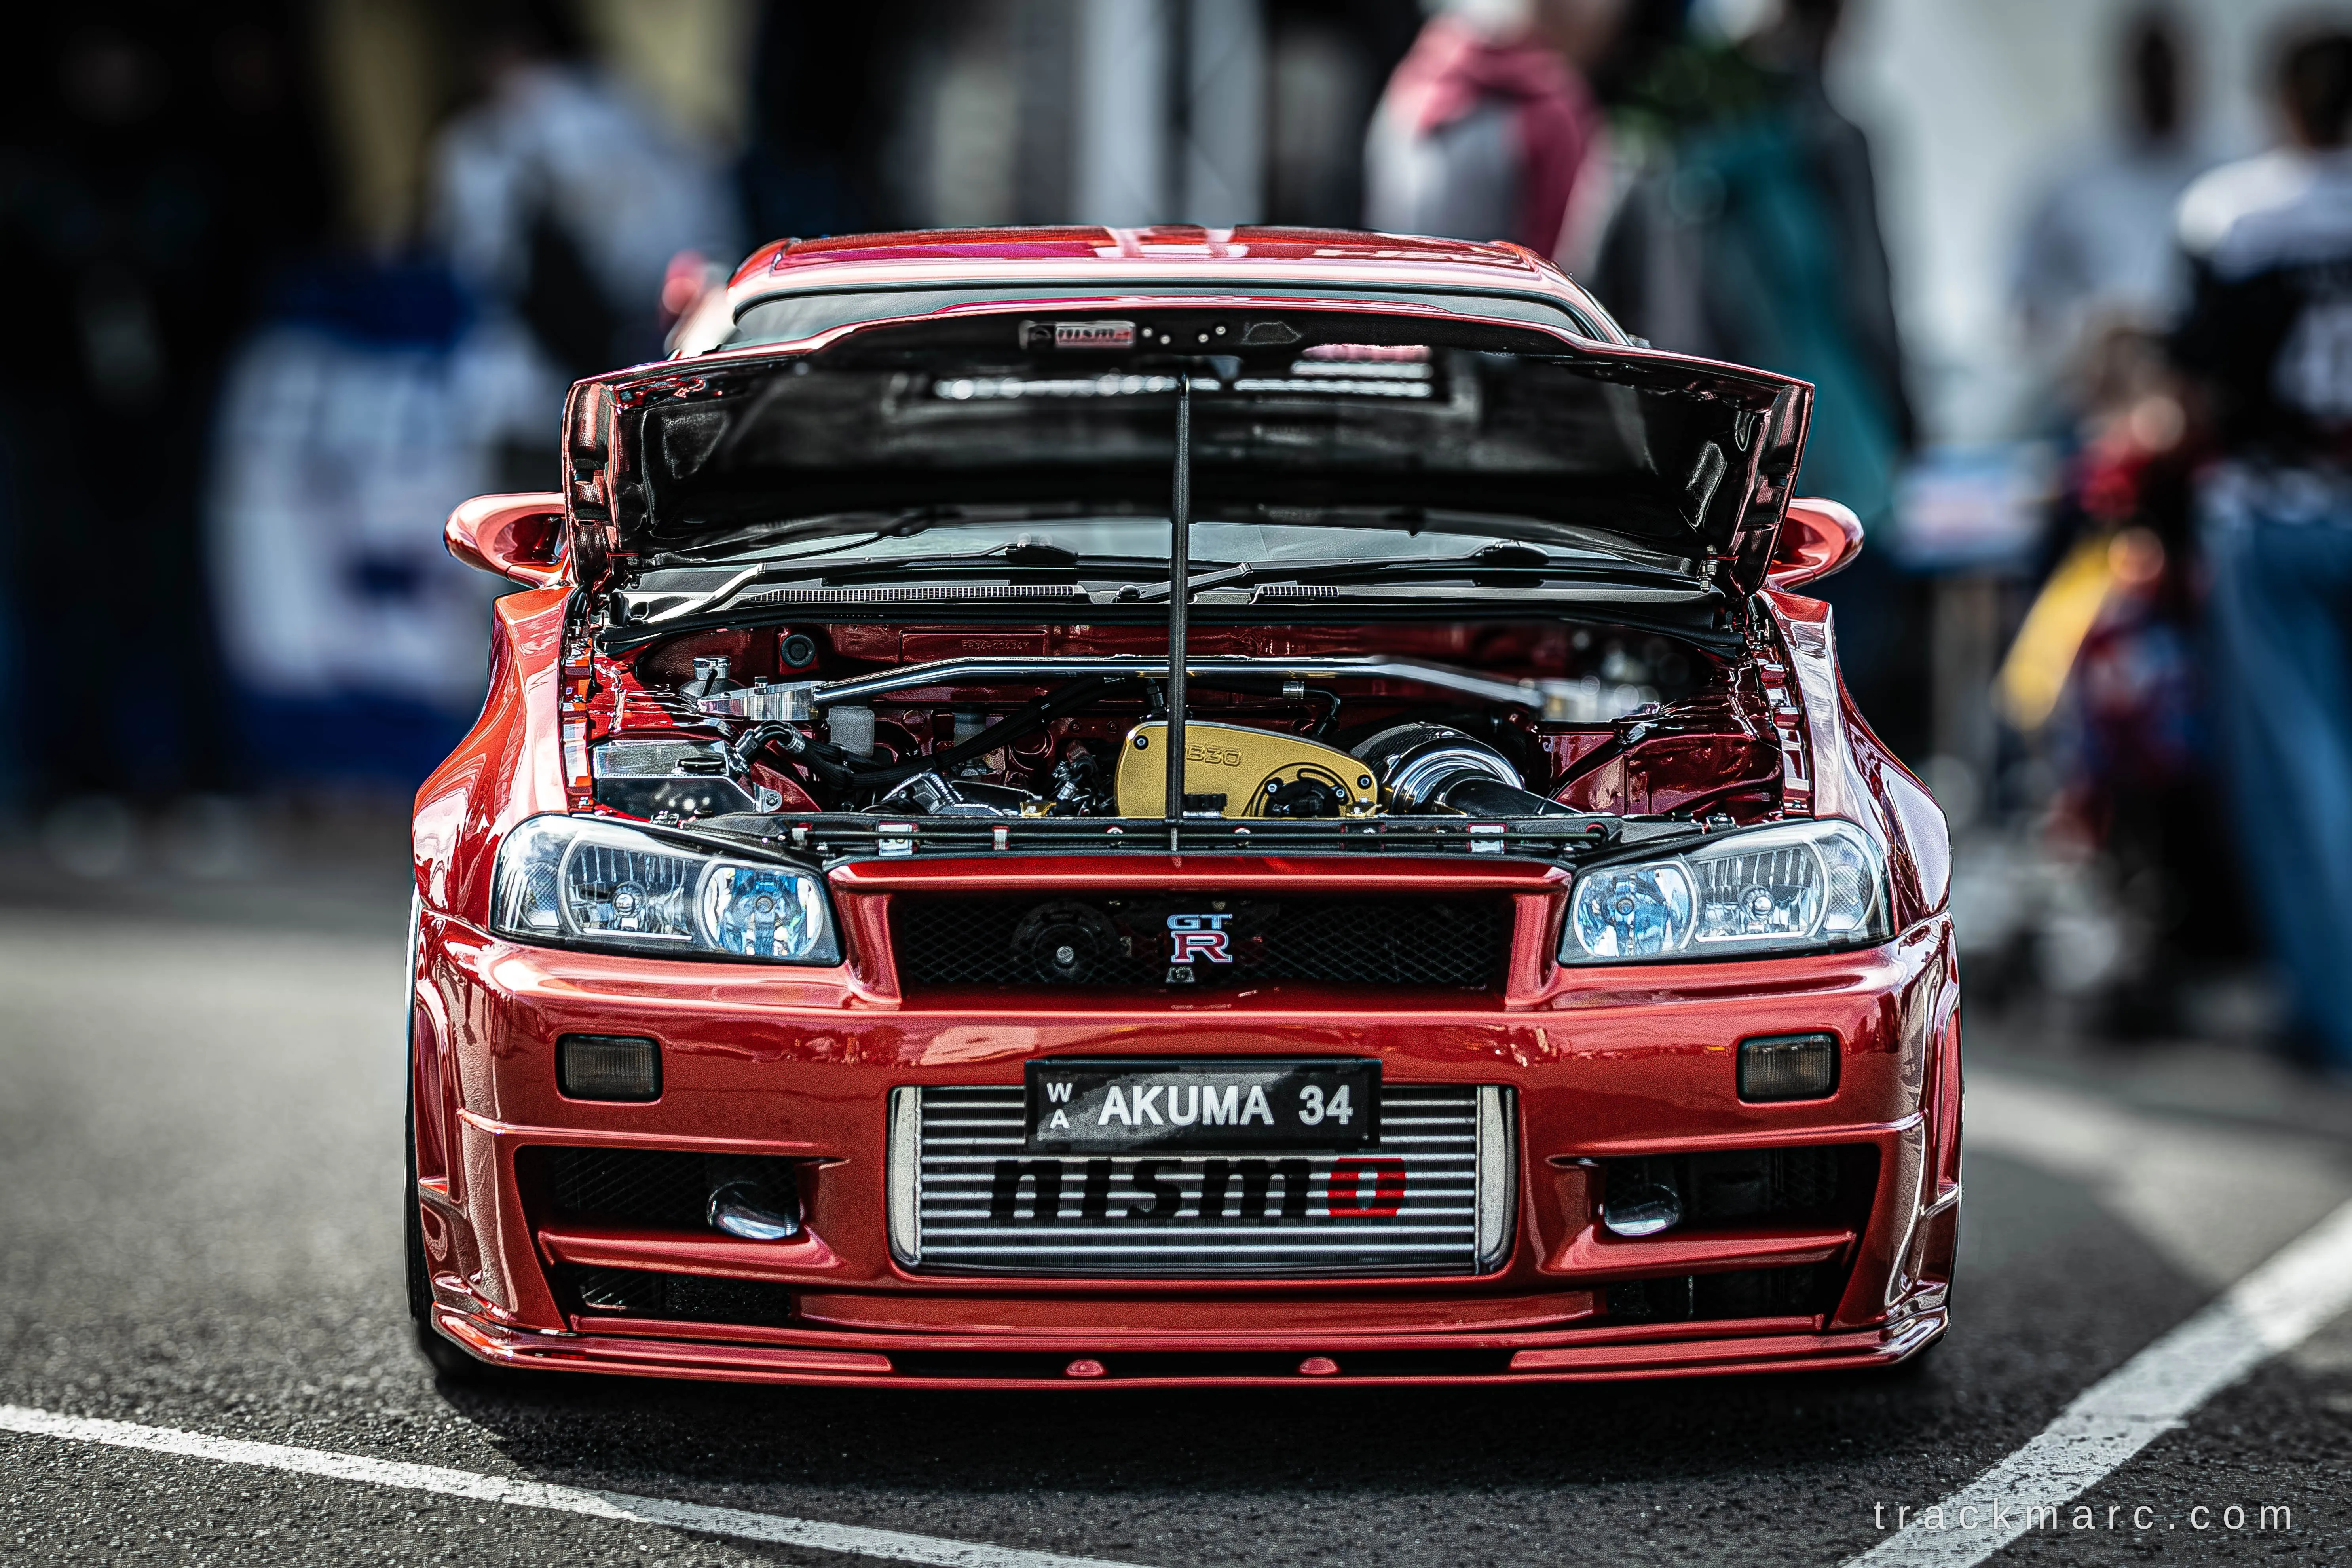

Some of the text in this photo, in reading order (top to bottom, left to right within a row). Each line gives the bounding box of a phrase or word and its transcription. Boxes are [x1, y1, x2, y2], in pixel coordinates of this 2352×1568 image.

[1185, 744, 1241, 767] B30
[1167, 914, 1232, 929] GT
[1171, 930, 1232, 962] R
[1097, 1085, 1353, 1126] AKUMA 34
[991, 1158, 1406, 1218] nismo
